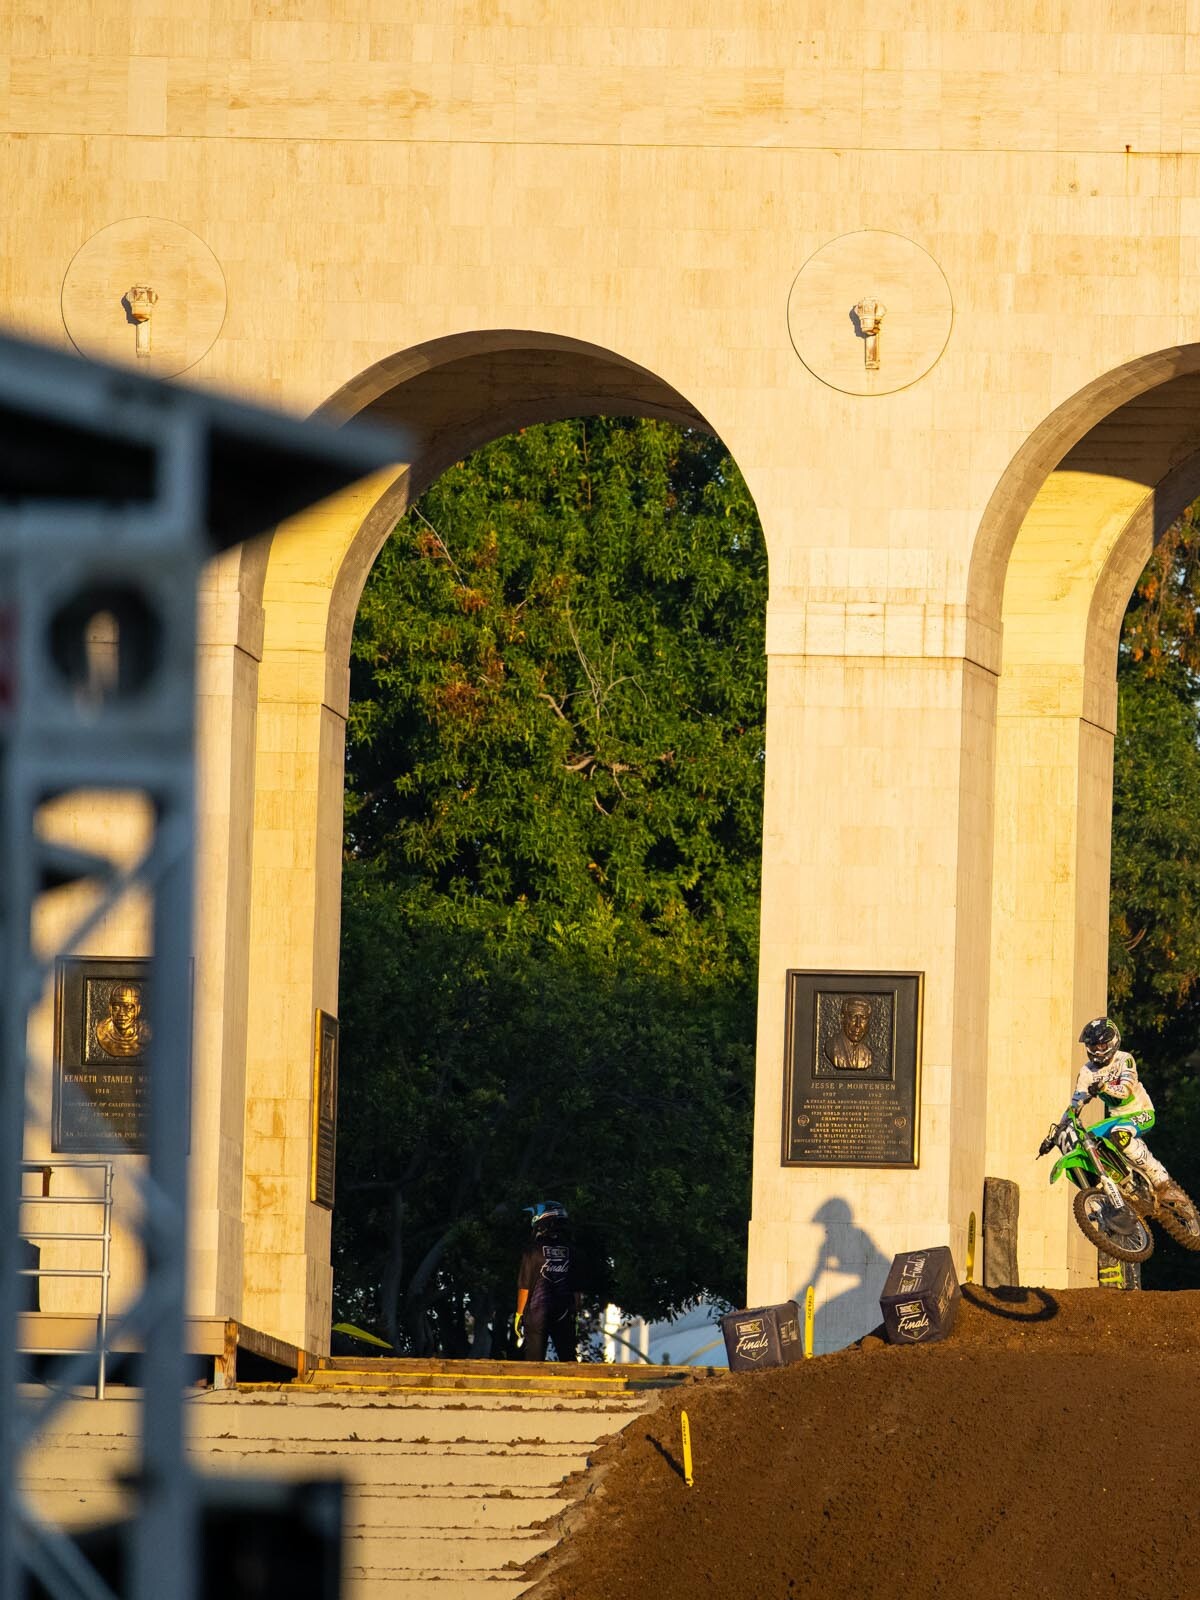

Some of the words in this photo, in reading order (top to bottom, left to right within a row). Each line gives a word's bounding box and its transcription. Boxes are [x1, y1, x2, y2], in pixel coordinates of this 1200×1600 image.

[64, 1074, 97, 1083] KENNETH
[102, 1075, 134, 1084] STANLEY
[898, 1312, 929, 1333] Finals
[736, 1332, 768, 1353] Finals
